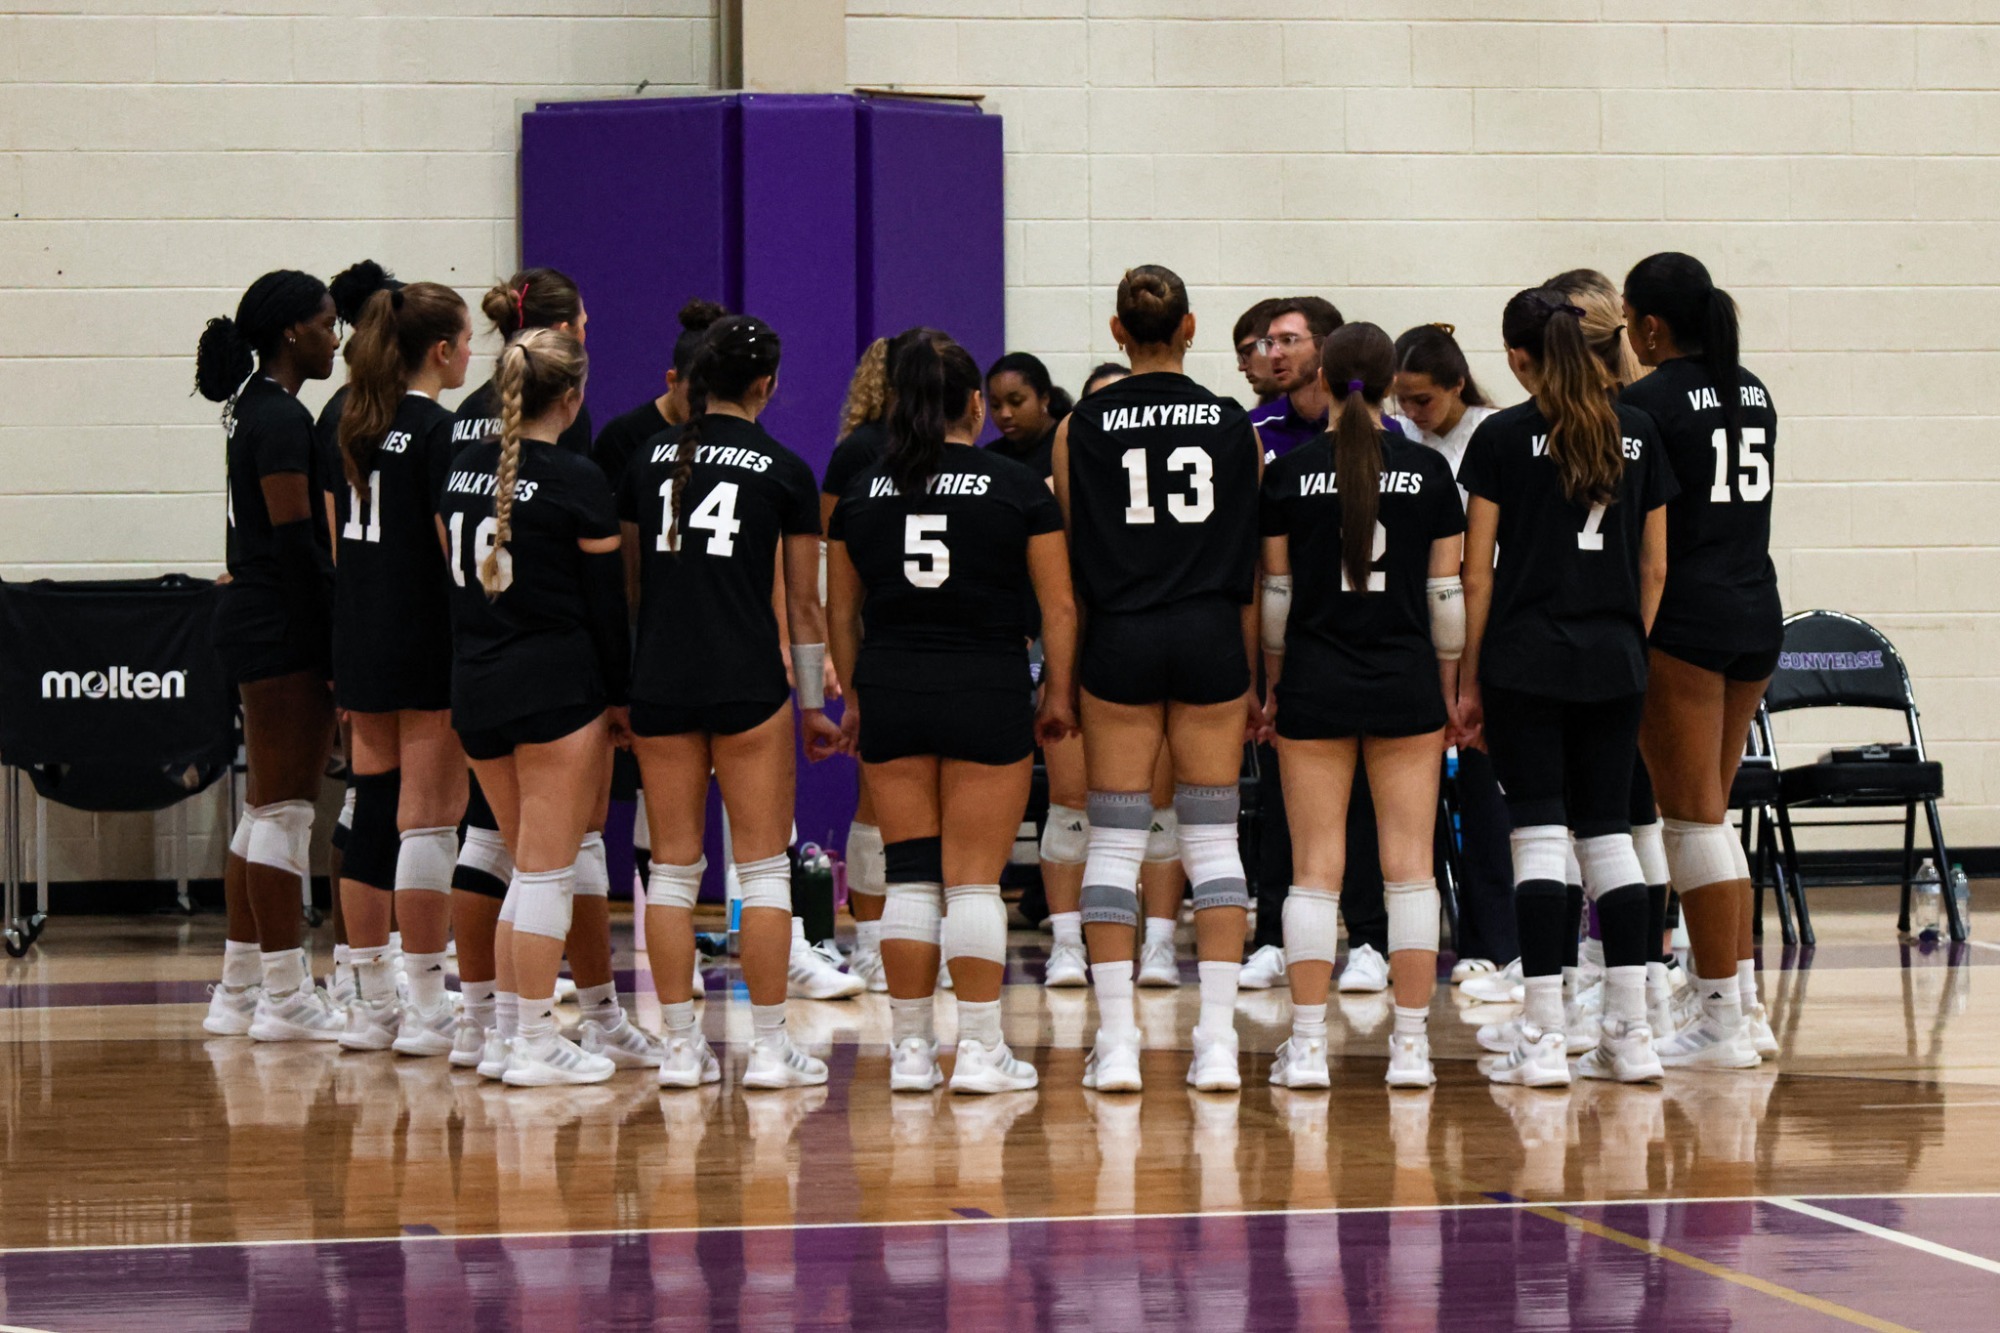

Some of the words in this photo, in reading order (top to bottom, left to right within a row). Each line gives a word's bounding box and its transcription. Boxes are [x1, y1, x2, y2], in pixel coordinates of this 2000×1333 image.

[1687, 385, 1768, 411] VALRIES
[1102, 403, 1221, 432] VALKYRIES
[650, 443, 773, 473] VAKYRIES
[1710, 427, 1771, 503] 15
[447, 471, 539, 502] VALKYES
[868, 472, 991, 498] VAYRIES
[1121, 446, 1215, 524] 13
[1299, 471, 1423, 497] VALRIES
[343, 470, 381, 543] 11
[656, 478, 741, 557] 14
[903, 514, 950, 588] 5
[1777, 650, 1884, 670] CONVERSE
[41, 666, 185, 700] molten
